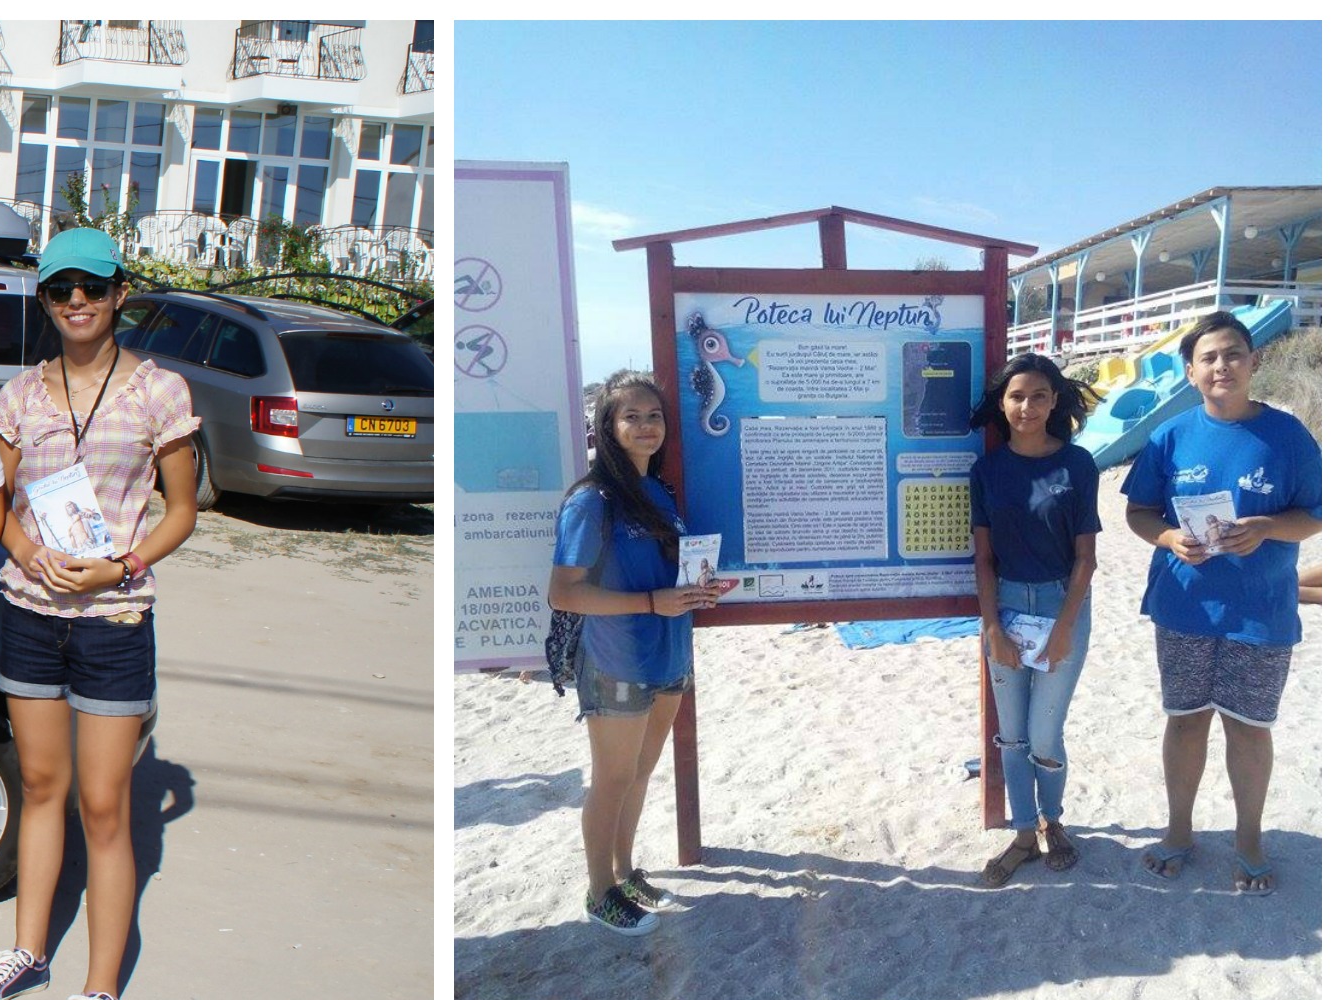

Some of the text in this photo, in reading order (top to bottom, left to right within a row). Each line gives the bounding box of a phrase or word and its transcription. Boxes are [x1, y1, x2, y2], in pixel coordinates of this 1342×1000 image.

[733, 296, 930, 330] Poteca lui Neptun
[360, 418, 376, 431] CN
[378, 418, 410, 432] 6703
[462, 513, 494, 523] zona
[467, 585, 539, 599] AMENDA
[461, 601, 541, 616] 18/09/2006
[455, 637, 466, 649] E
